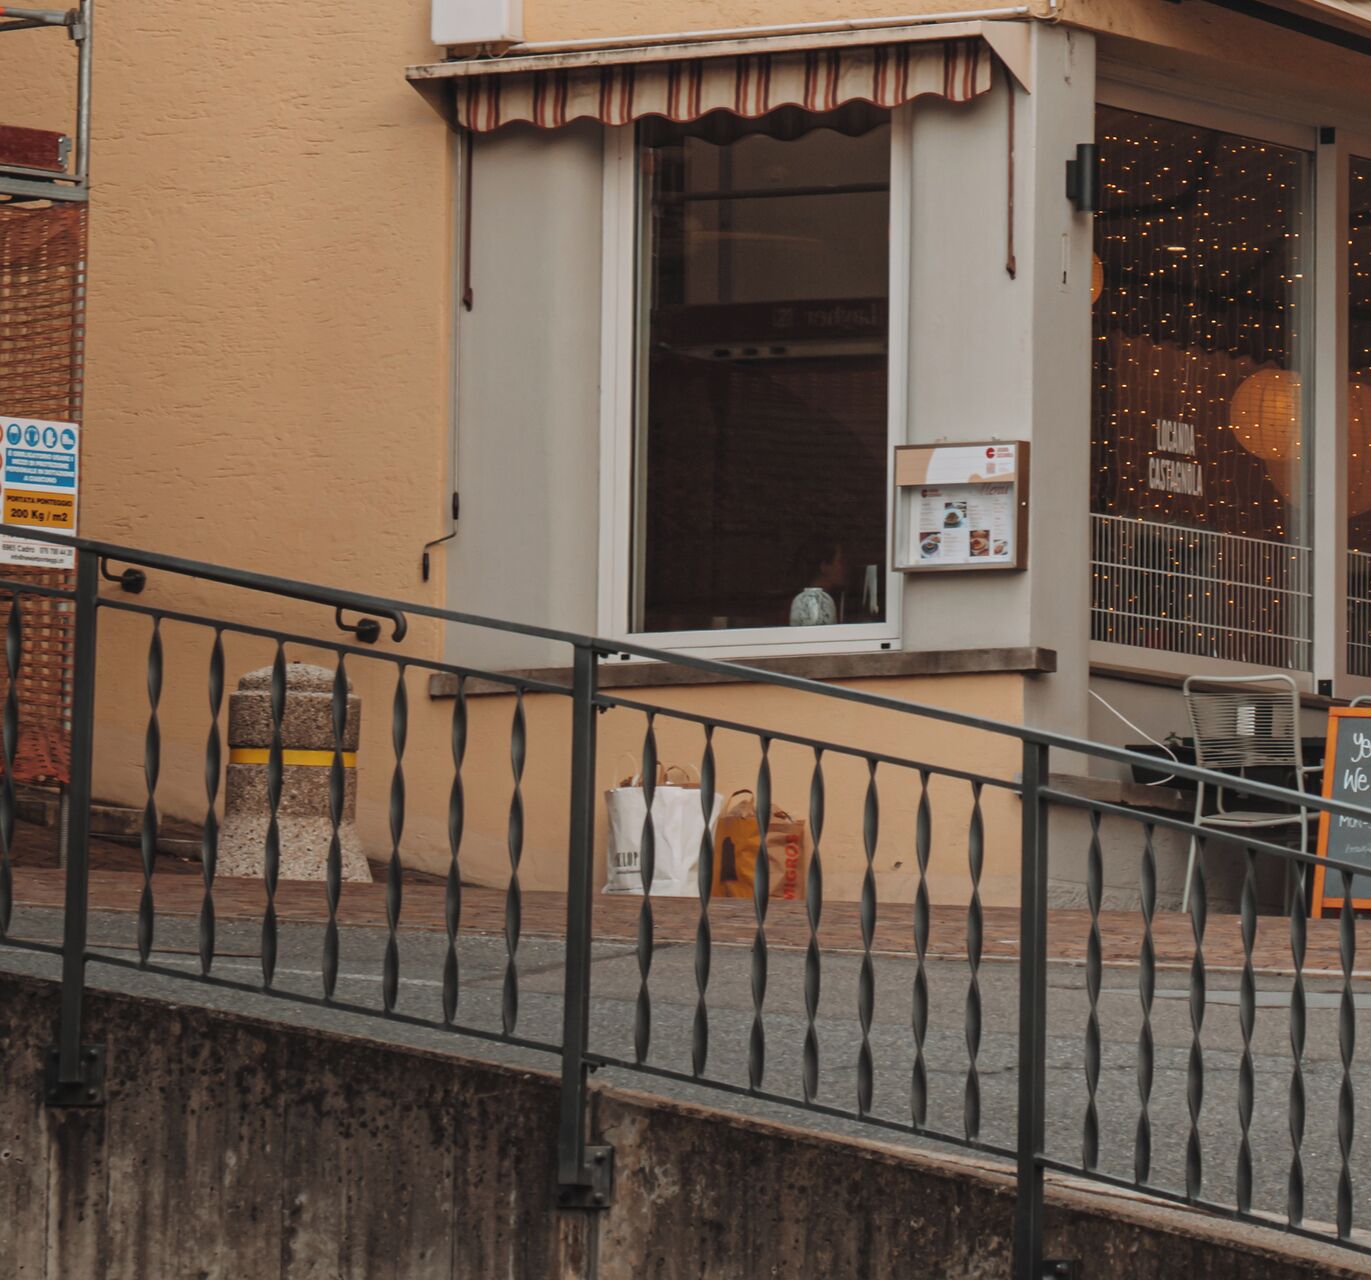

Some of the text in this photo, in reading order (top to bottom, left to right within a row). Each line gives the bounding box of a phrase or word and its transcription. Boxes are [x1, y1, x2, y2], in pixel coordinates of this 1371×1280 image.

[1156, 419, 1195, 456] LOCANDA
[11, 508, 28, 518] 200
[31, 509, 44, 522] Kg
[52, 512, 67, 522] m2
[1343, 767, 1370, 792] We
[784, 834, 800, 900] MIGROS
